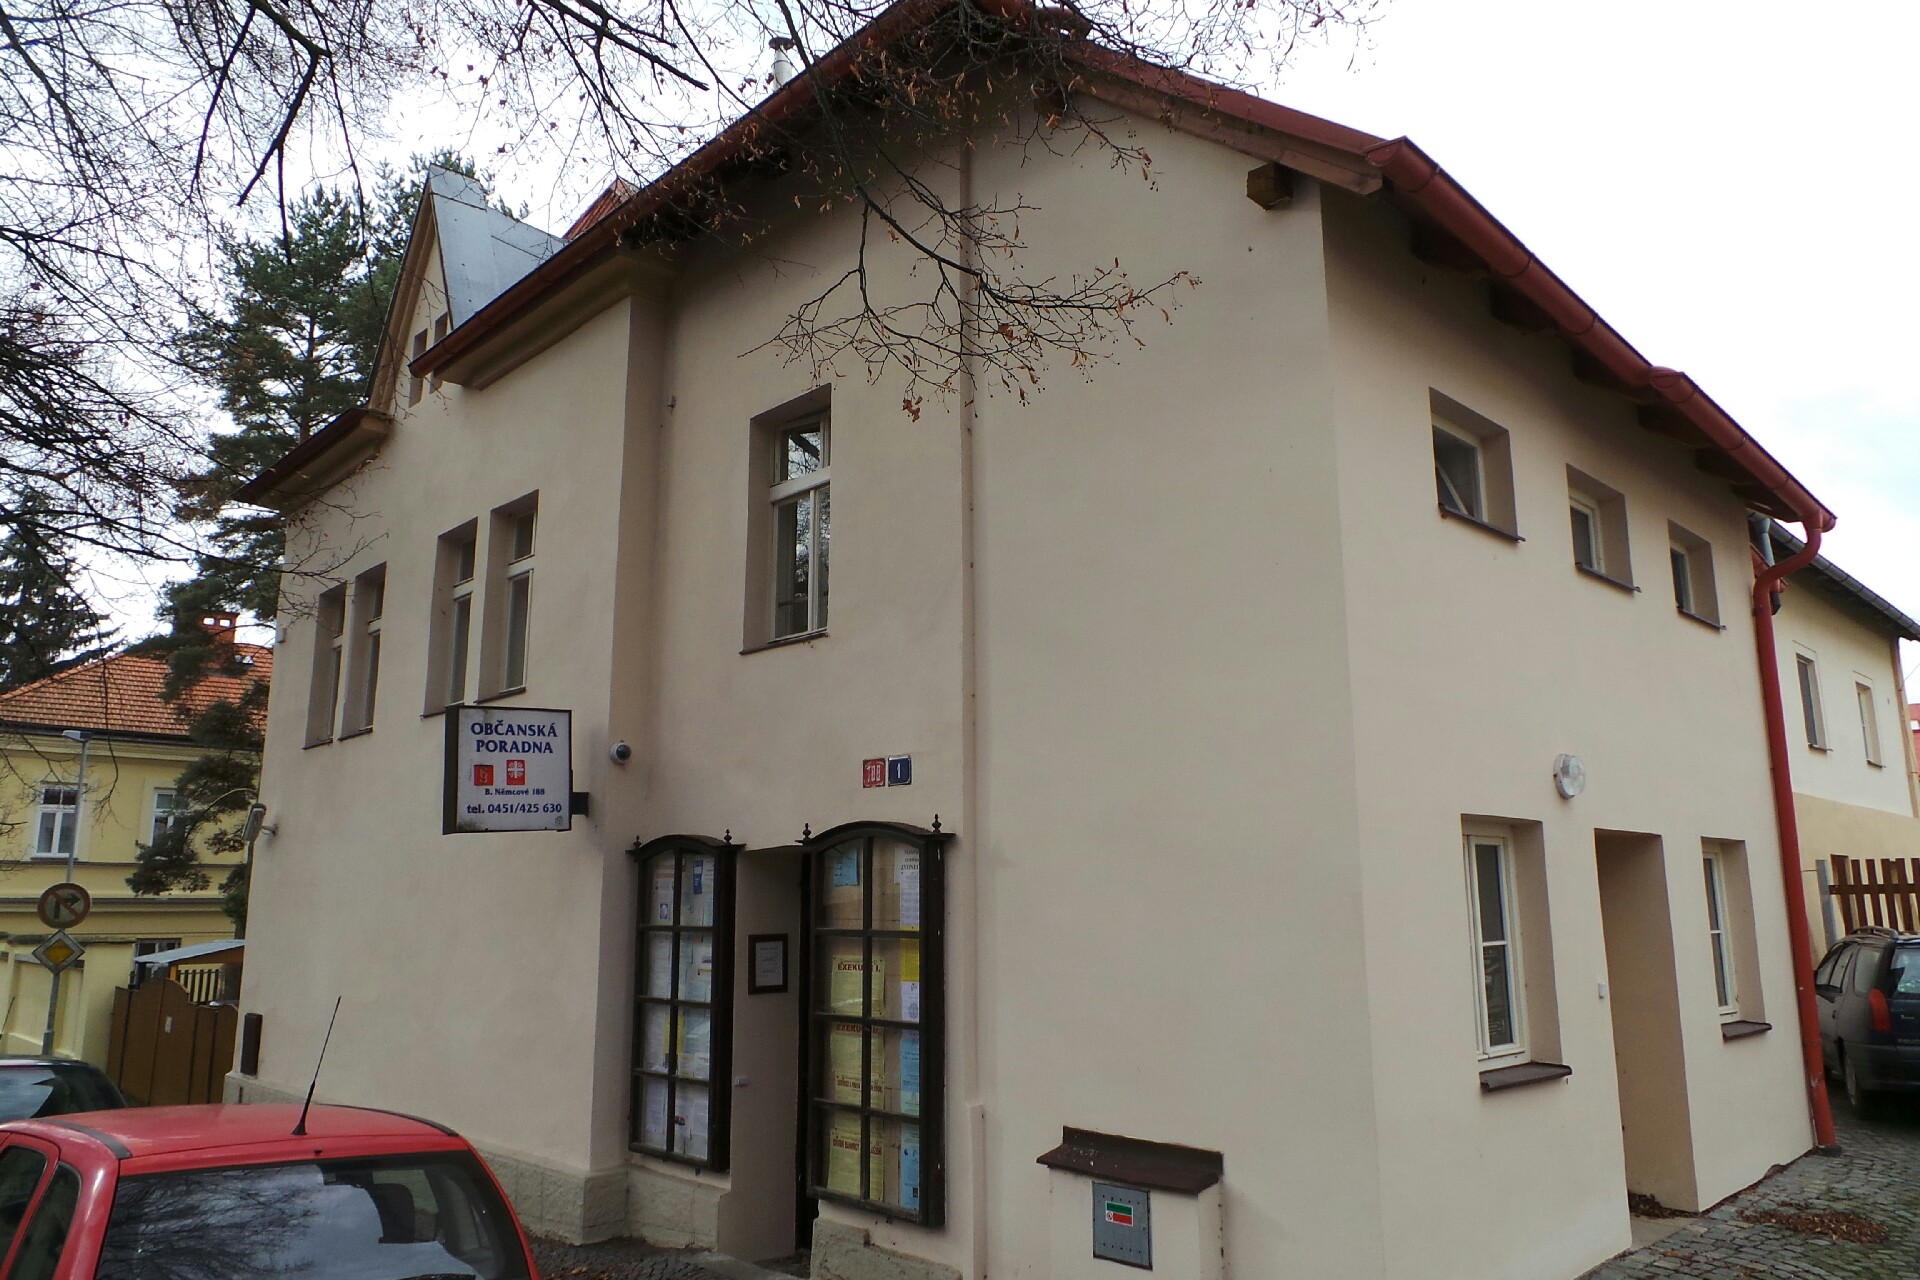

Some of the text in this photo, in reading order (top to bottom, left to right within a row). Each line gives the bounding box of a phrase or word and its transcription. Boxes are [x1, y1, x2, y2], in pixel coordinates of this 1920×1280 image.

[470, 719, 558, 738] OBČANSKÁ
[476, 739, 554, 754] PORADNA
[896, 762, 901, 779] 1
[466, 802, 562, 814] tel. 0451/425 630
[837, 963, 864, 971] EXEKU
[836, 1024, 861, 1032] EXEKU
